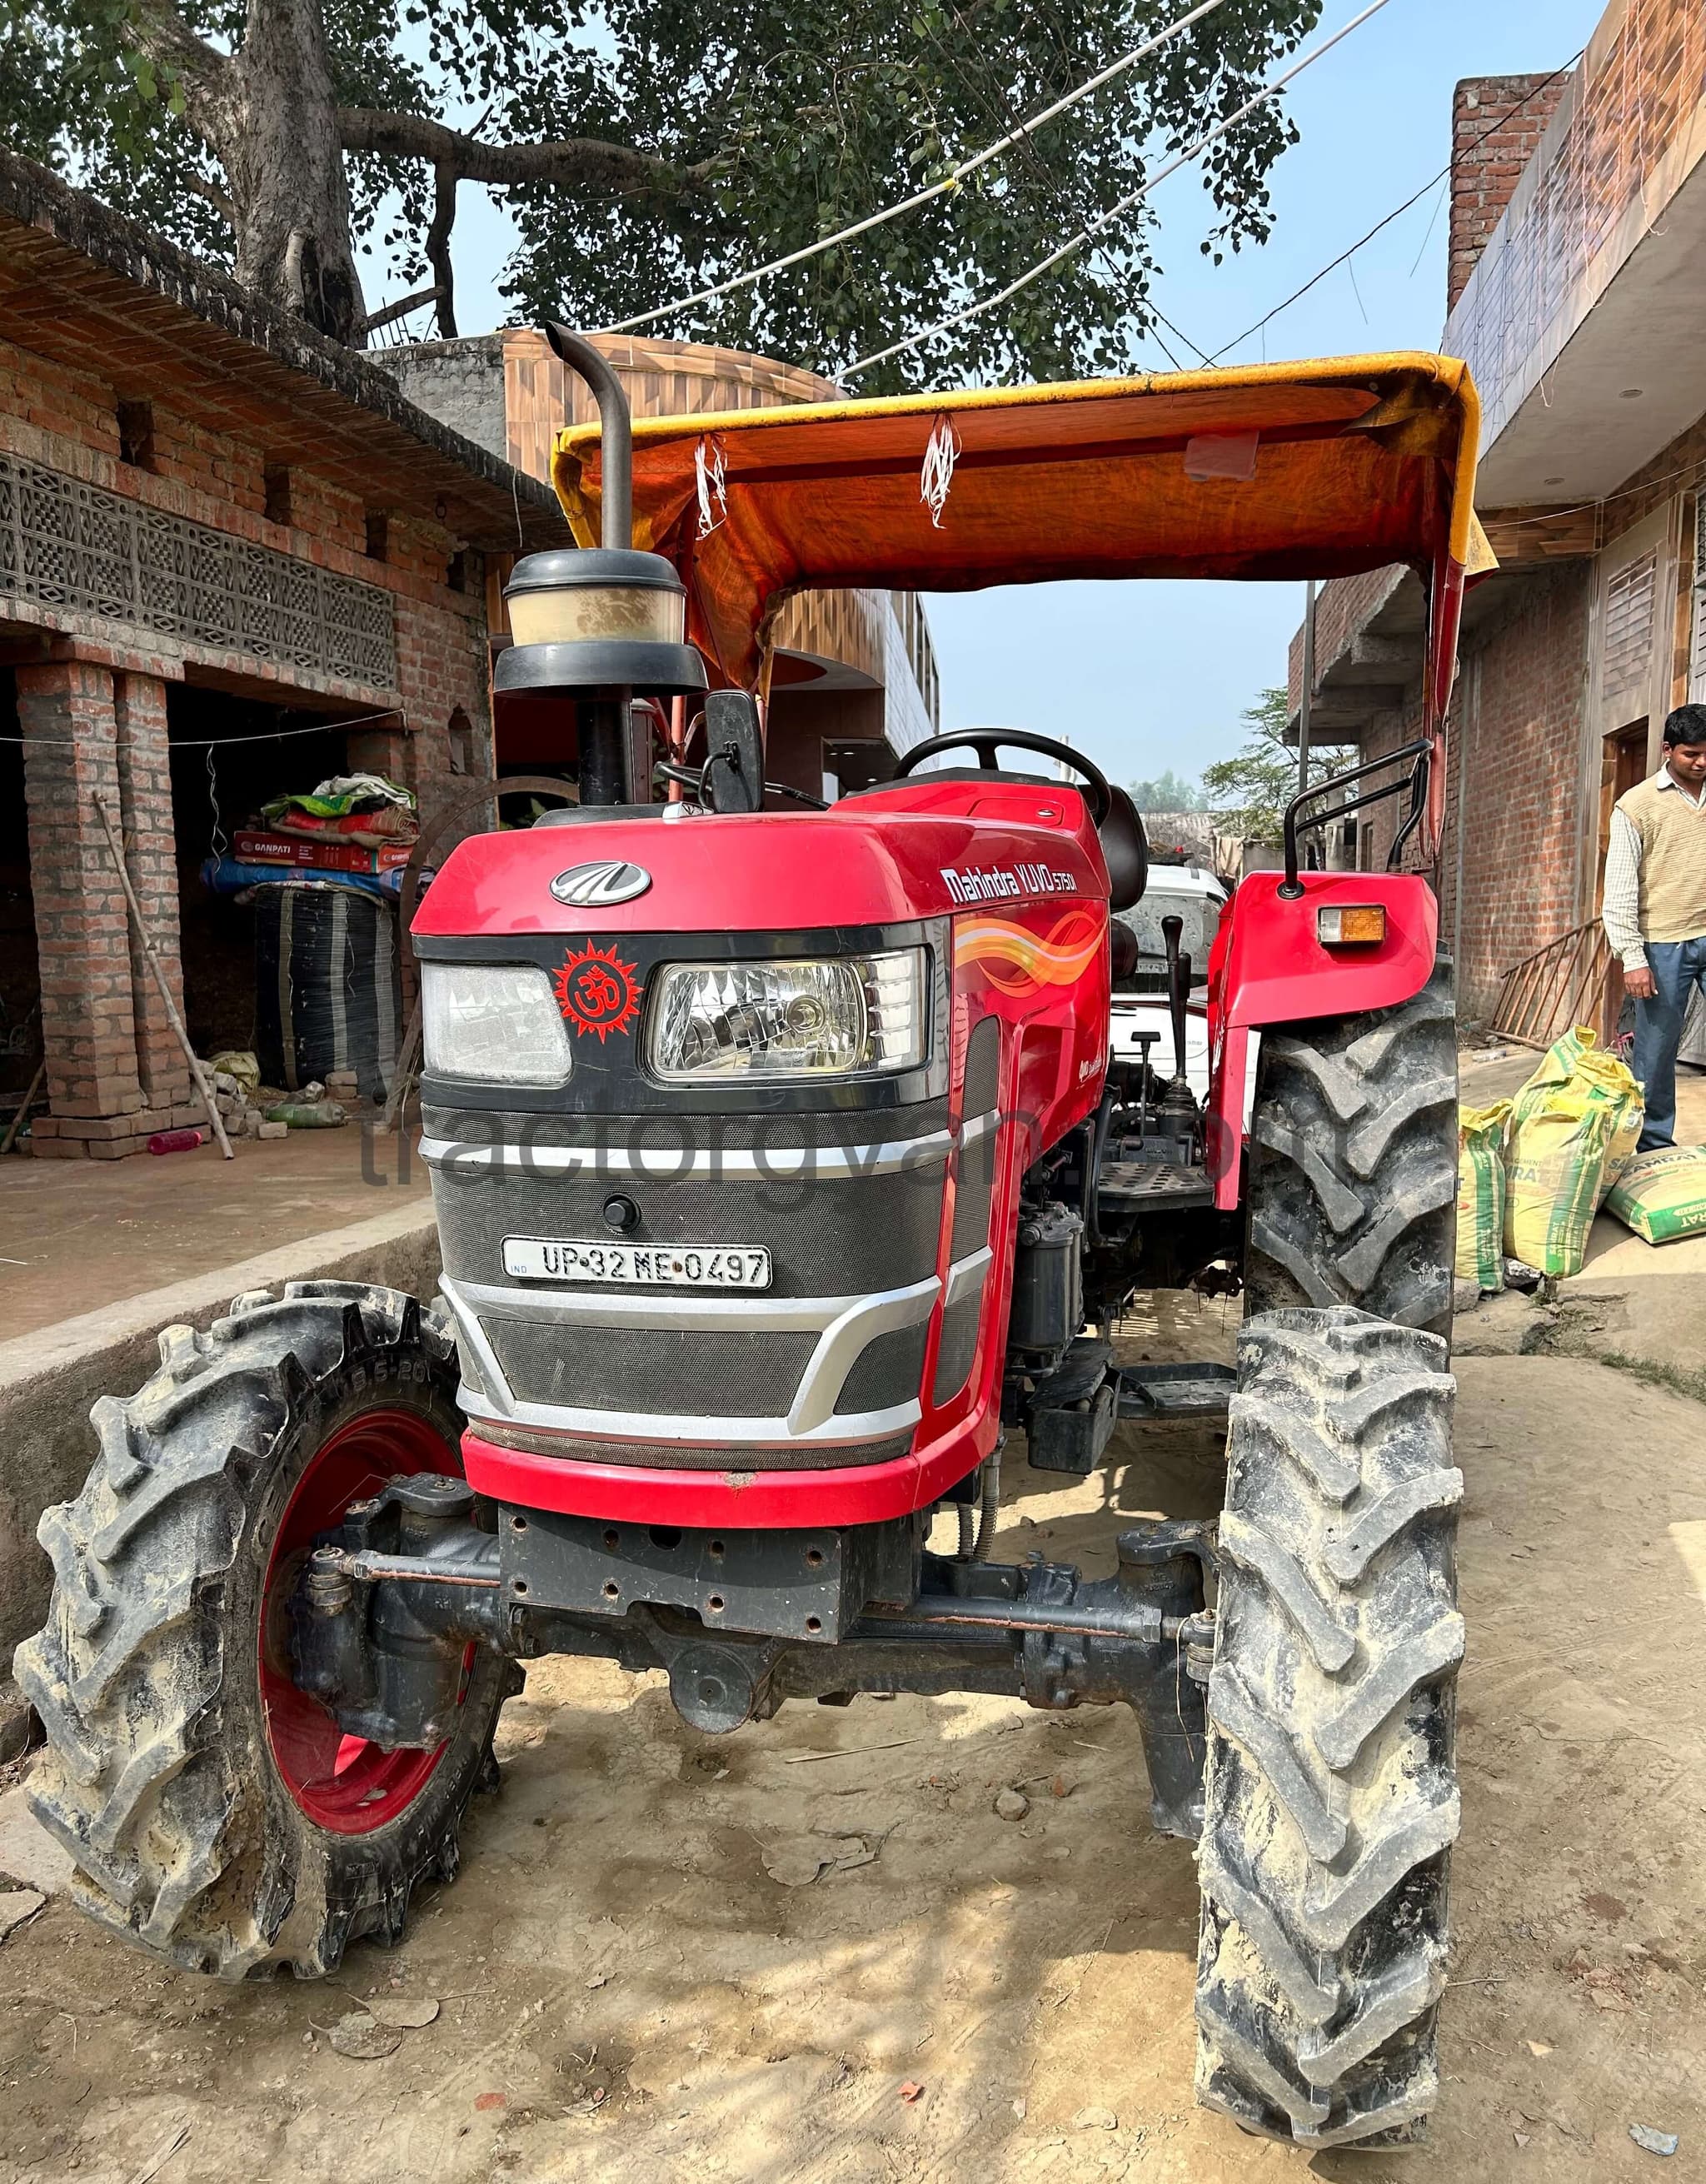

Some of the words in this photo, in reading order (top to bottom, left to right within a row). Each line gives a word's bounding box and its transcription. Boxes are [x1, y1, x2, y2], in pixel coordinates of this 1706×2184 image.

[254, 843, 291, 854] GANPATI
[940, 865, 1020, 903] Mahindra
[1013, 863, 1055, 894] YUVO
[511, 1265, 527, 1274] IND
[685, 1253, 764, 1283] 0497
